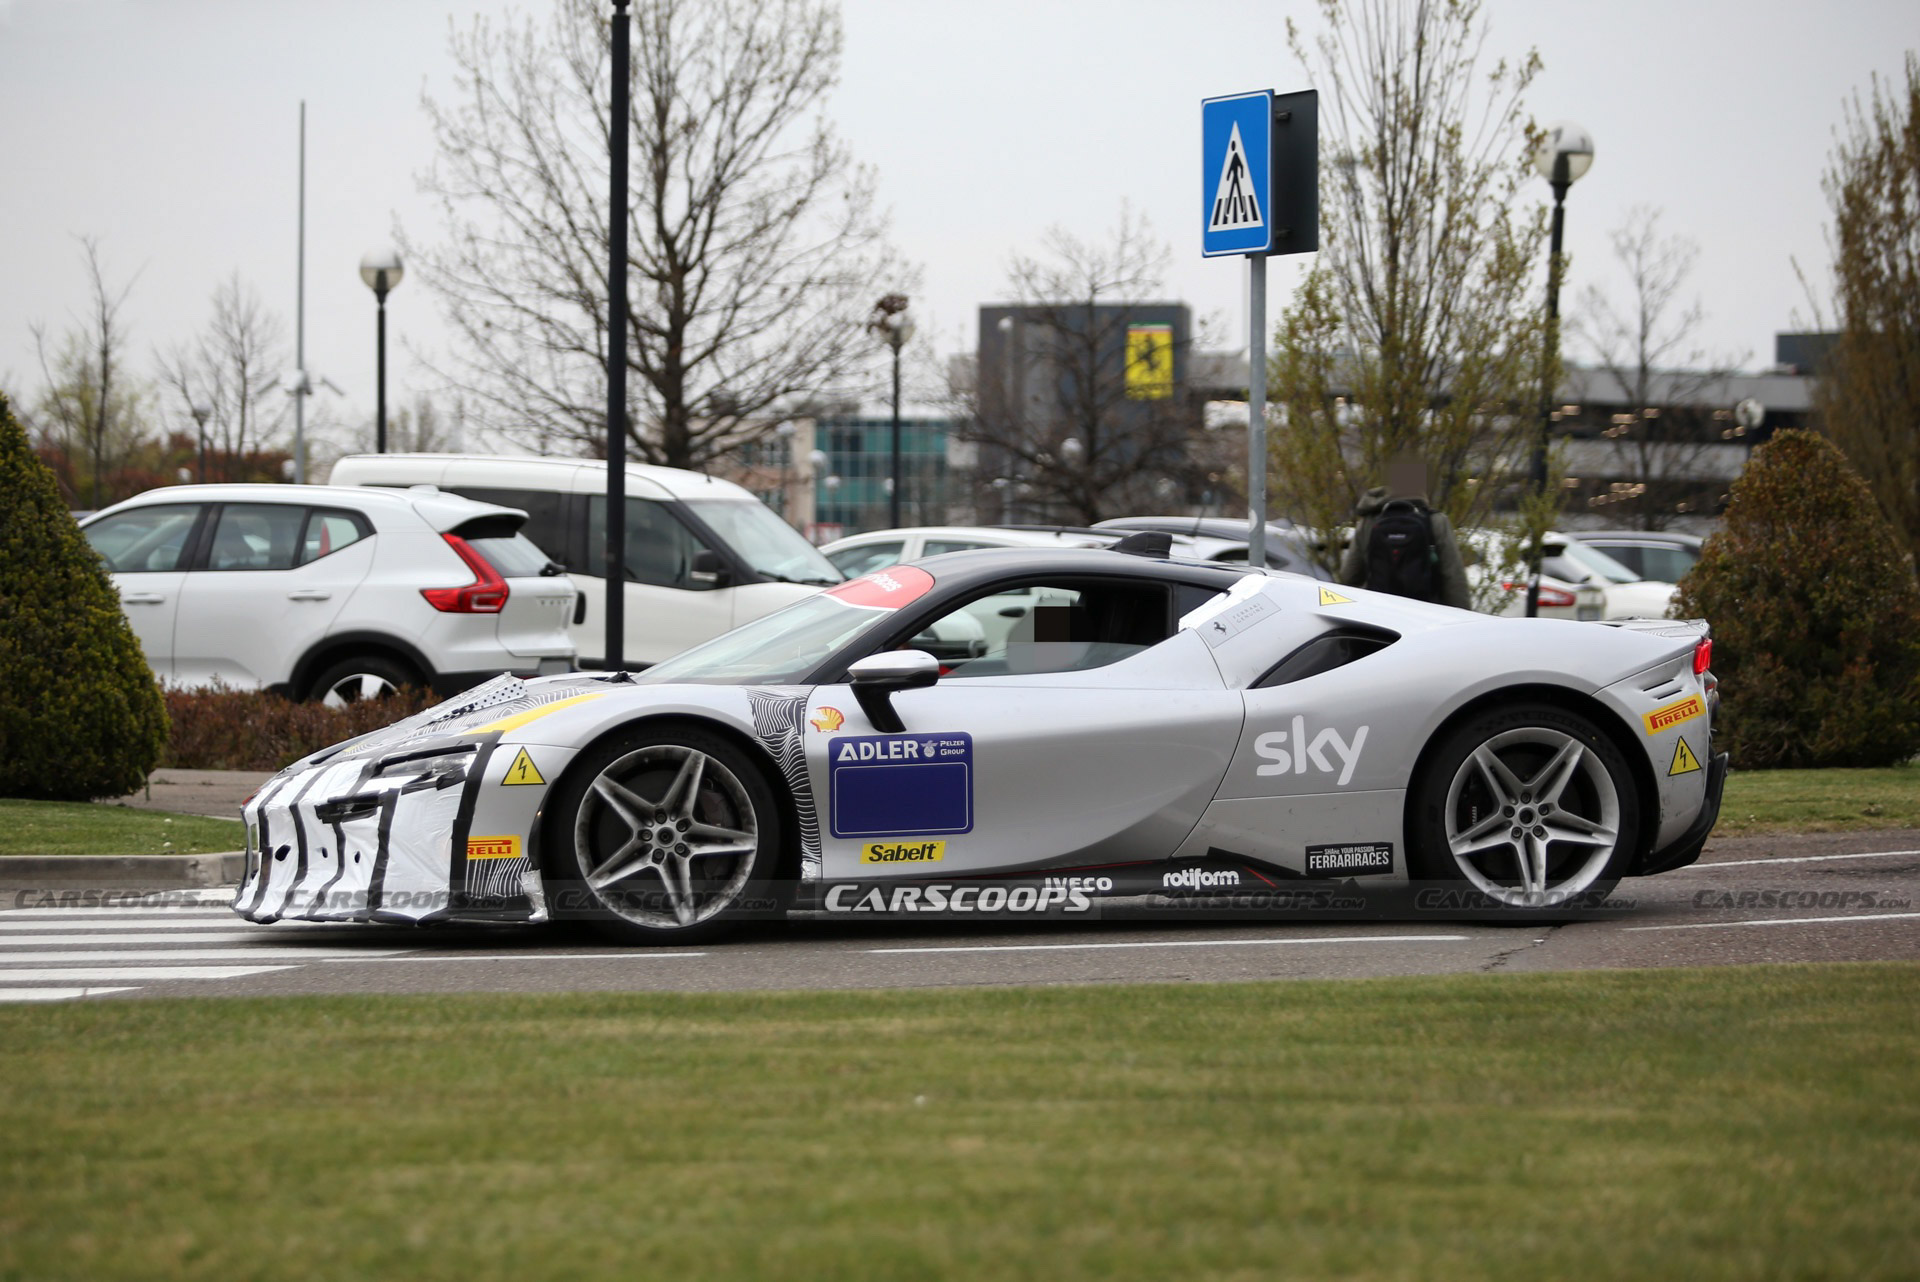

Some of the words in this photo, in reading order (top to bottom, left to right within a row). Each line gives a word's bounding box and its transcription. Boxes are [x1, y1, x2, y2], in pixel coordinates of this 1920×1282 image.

[1649, 699, 1699, 729] PIRELLI
[837, 740, 919, 761] ADLER
[940, 748, 965, 756] GROUP
[1254, 715, 1369, 785] sky
[467, 840, 513, 855] RELLI
[869, 843, 937, 862] Sabelt
[1309, 851, 1389, 869] FERRARIRACES
[1045, 877, 1113, 891] IVECO
[1163, 868, 1240, 890] rotiform
